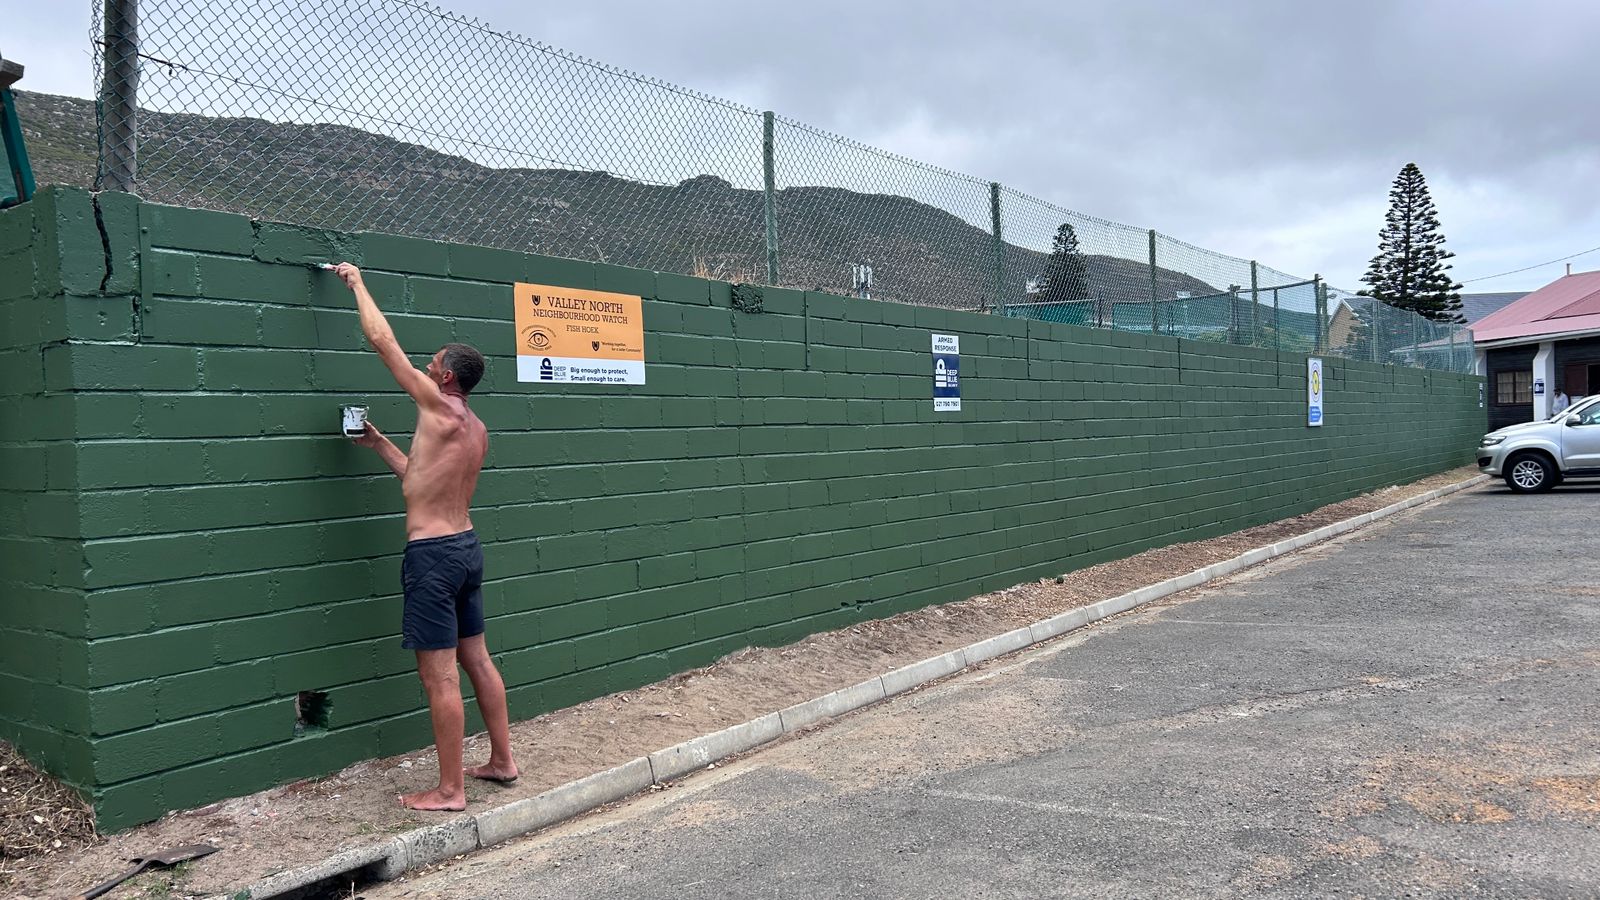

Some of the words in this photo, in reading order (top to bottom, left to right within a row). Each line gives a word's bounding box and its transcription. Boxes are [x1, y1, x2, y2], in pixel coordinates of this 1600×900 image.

[547, 296, 587, 311] VALLEY
[589, 300, 624, 314] NORTH
[533, 308, 601, 322] NEIGHBOURHOOD
[602, 316, 628, 325] WATCH
[566, 324, 580, 333] FISH
[581, 326, 599, 334] HOEK
[570, 366, 580, 374] Big
